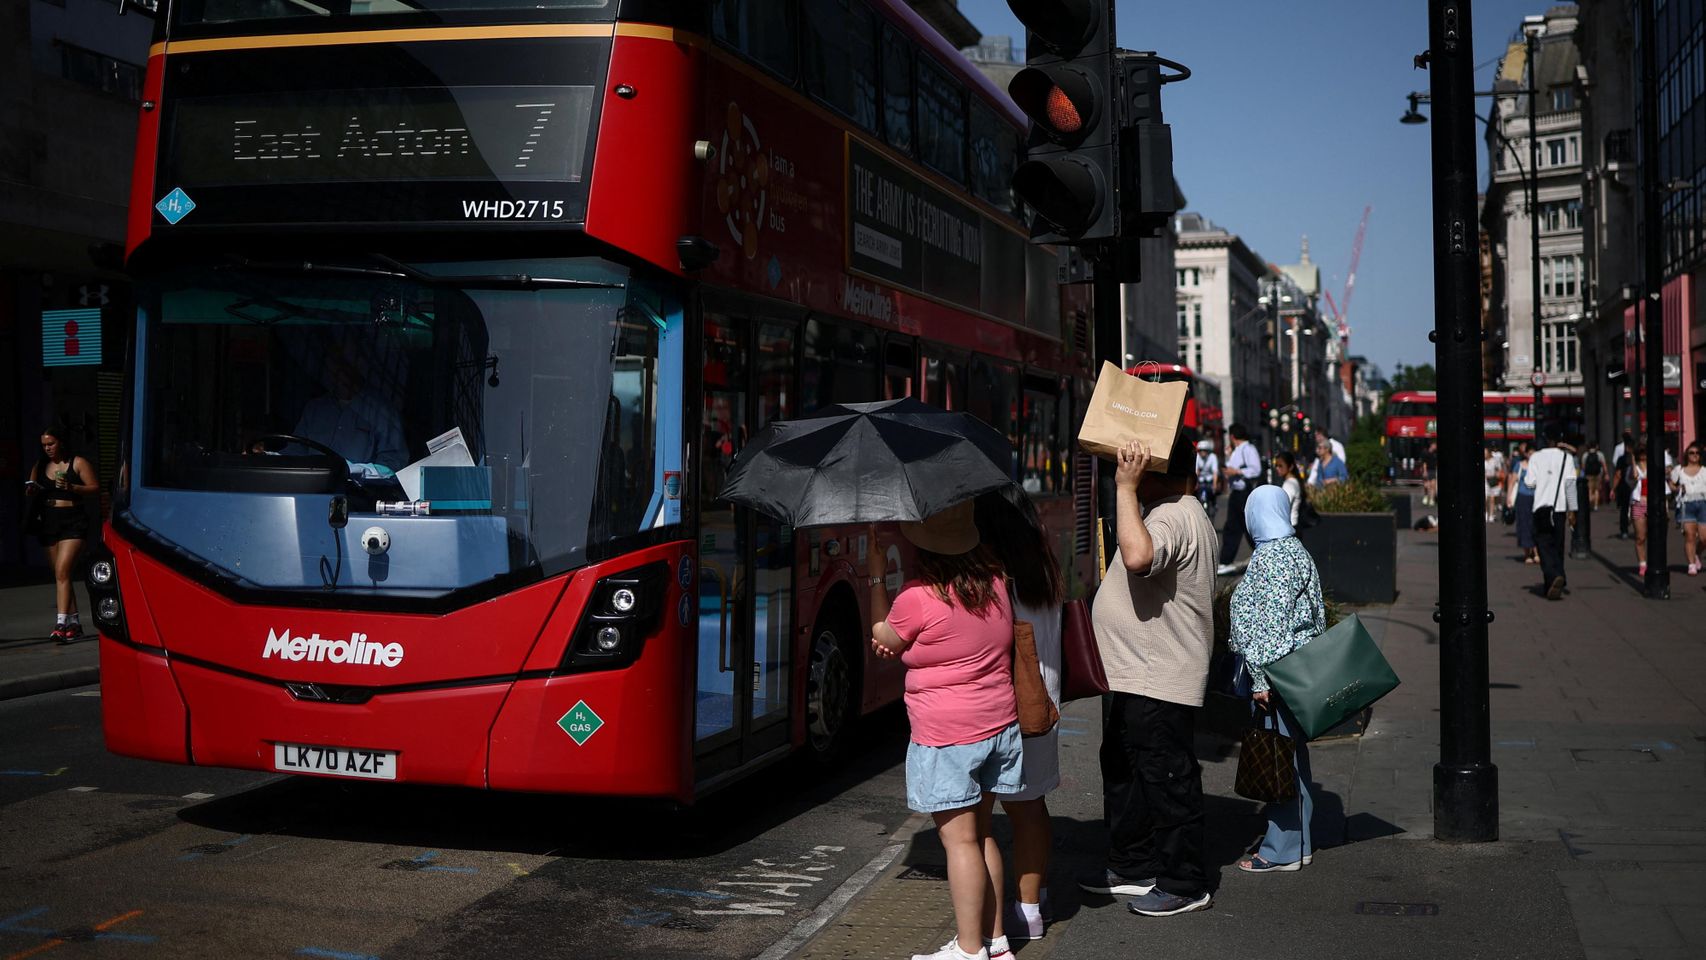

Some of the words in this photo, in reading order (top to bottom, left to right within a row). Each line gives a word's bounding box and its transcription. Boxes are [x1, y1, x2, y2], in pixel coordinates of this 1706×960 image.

[234, 120, 320, 160] East
[336, 116, 468, 158] Acton
[514, 103, 556, 168] 7
[462, 200, 565, 221] WHD2715
[854, 163, 875, 217] THE
[876, 175, 904, 231] ARMY
[906, 191, 915, 236] IS
[769, 208, 786, 232] bus
[844, 276, 892, 322] Metroline
[1112, 401, 1157, 418] UNIQLO.COM
[262, 627, 404, 668] Metroline
[570, 723, 591, 732] GAS
[284, 744, 338, 770] LK70
[345, 750, 386, 774] AZF
